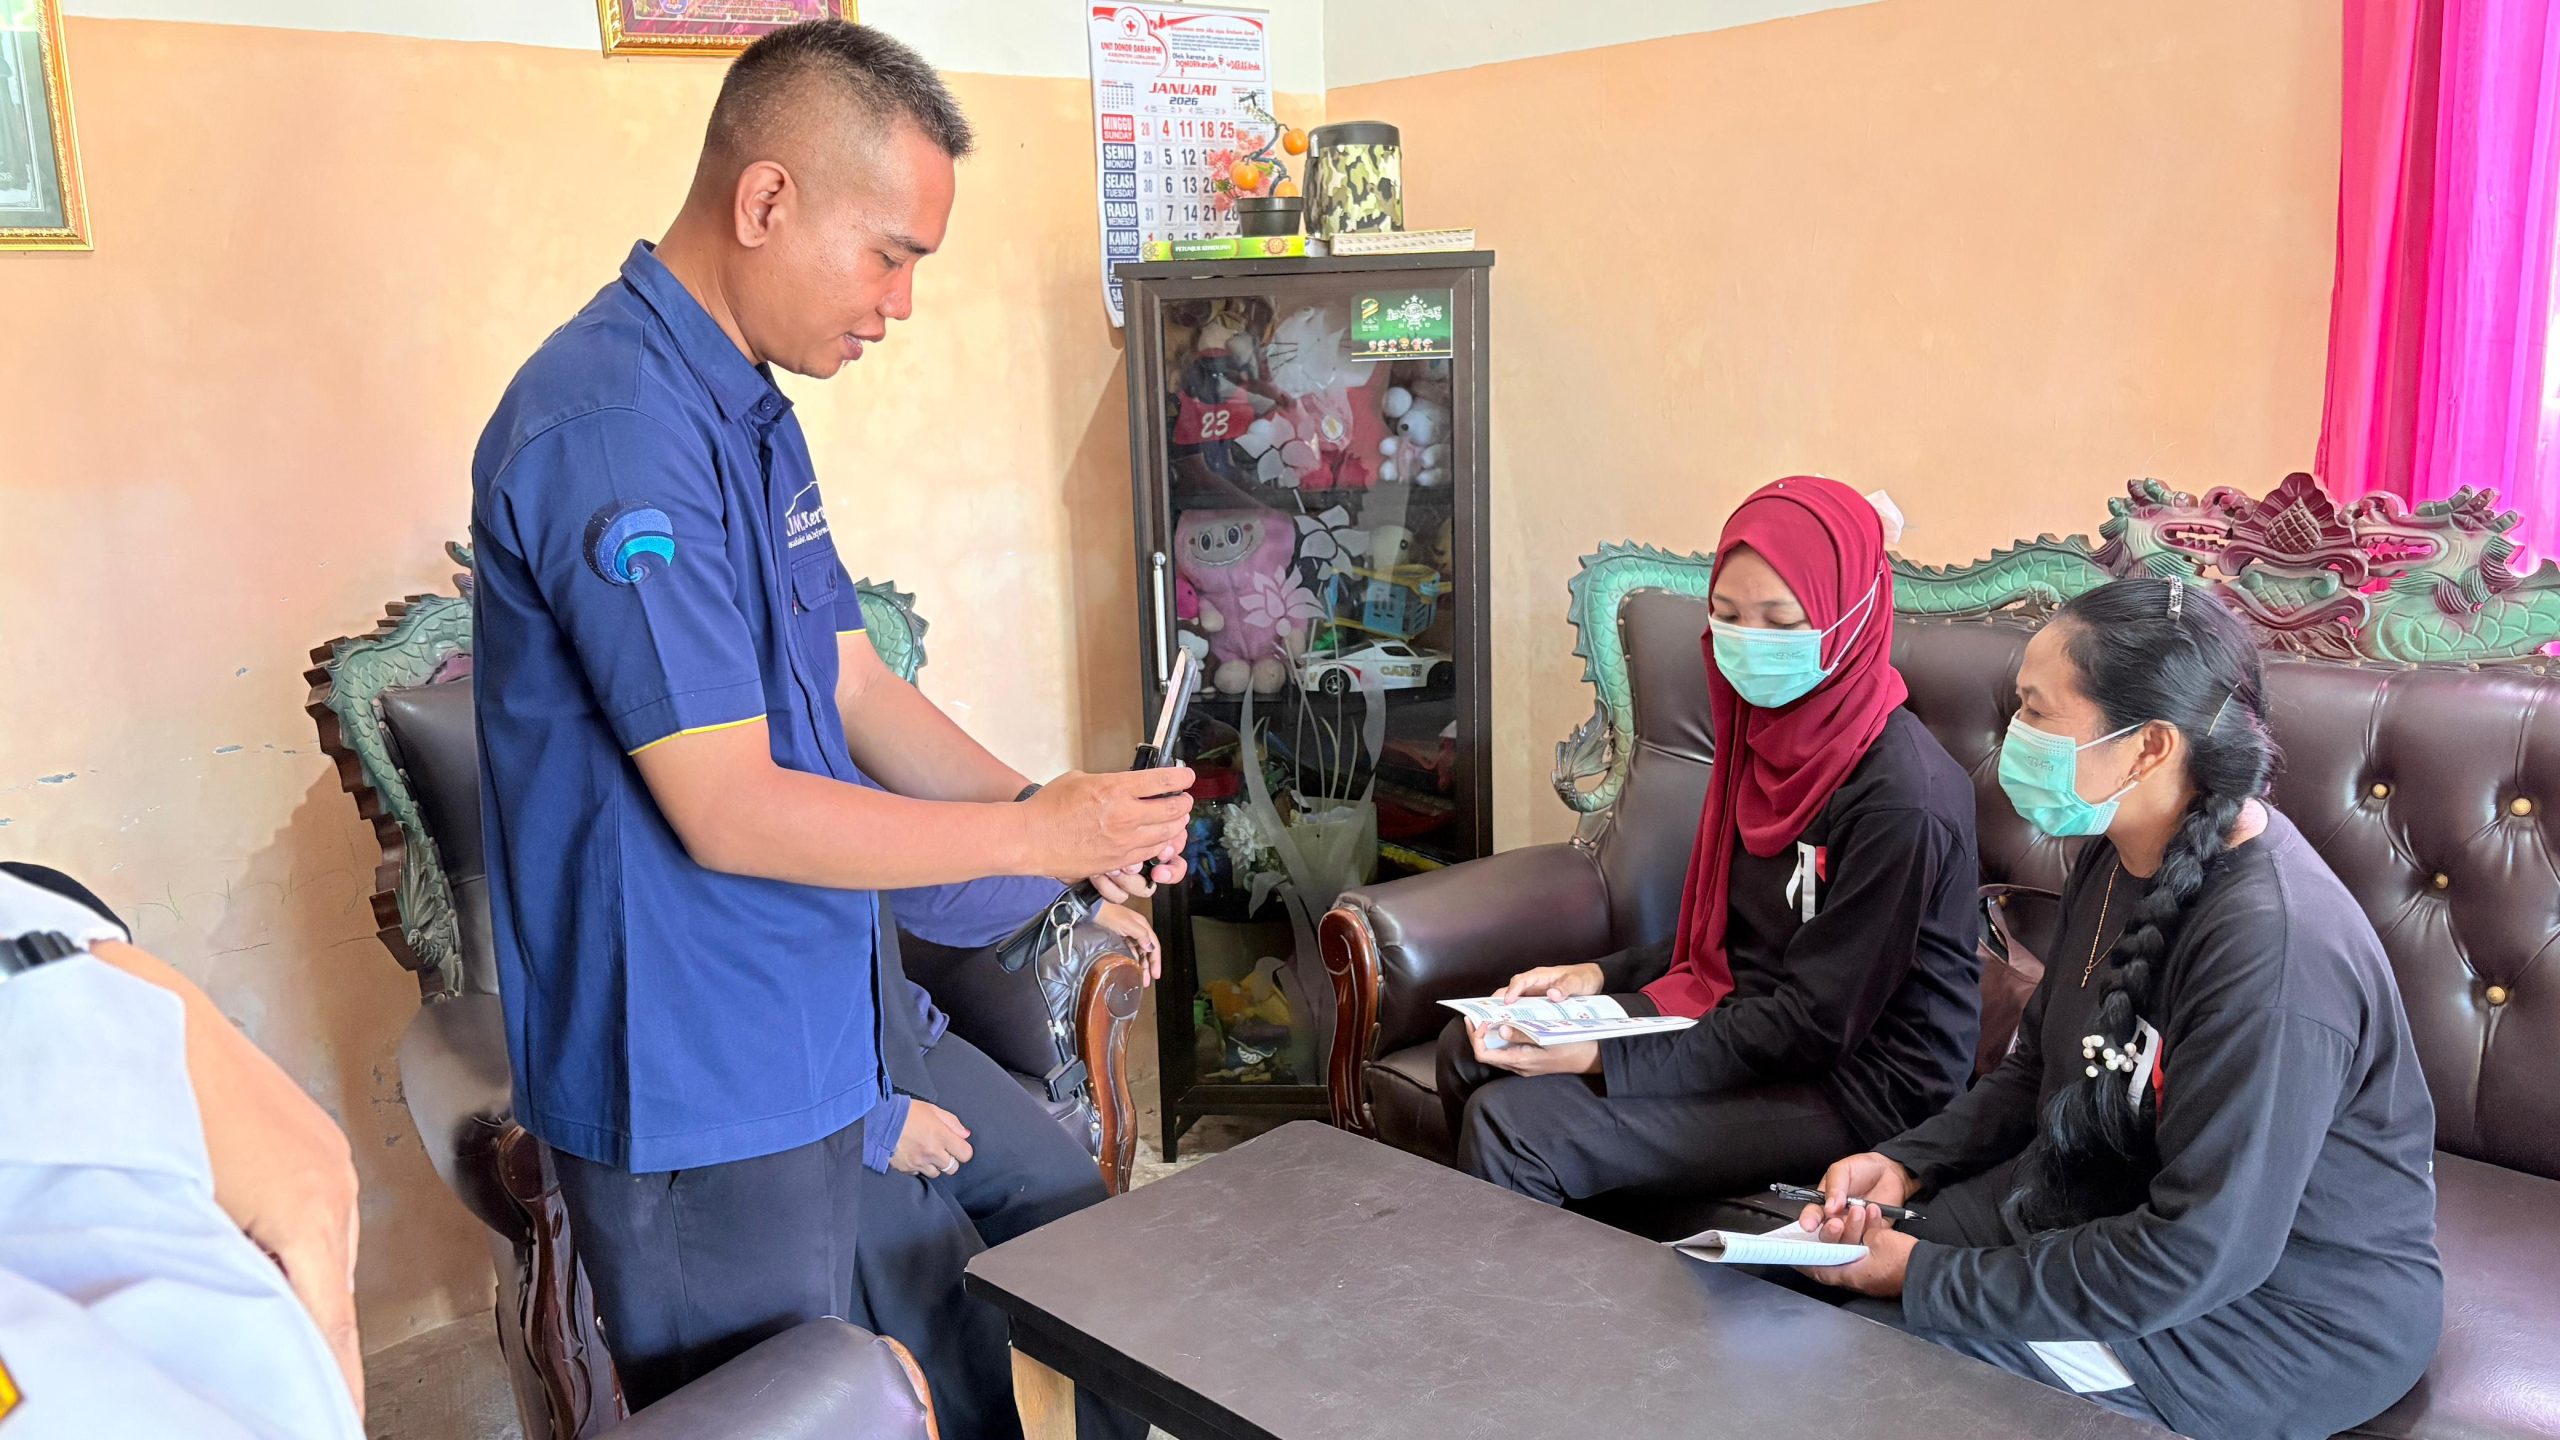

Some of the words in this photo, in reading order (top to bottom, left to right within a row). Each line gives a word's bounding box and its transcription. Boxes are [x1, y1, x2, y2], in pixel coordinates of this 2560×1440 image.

[1148, 82, 1217, 96] JANUARI
[1169, 97, 1199, 105] 2026
[1103, 116, 1132, 131] MINGGU
[1162, 119, 1170, 136] 4
[1179, 120, 1193, 138] 11
[1200, 120, 1214, 138] 18
[1219, 121, 1235, 139] 25
[1104, 131, 1133, 140] SUNDAY
[1105, 144, 1134, 160] SENIN
[1164, 148, 1173, 166] 5
[1181, 148, 1197, 166] 12
[1105, 160, 1134, 169] MONDAY
[1105, 173, 1135, 189] SELASA
[1165, 176, 1173, 194] 6
[1183, 176, 1197, 194] 13
[1105, 189, 1135, 197] TUESDAY
[1106, 202, 1136, 217] RABU
[1167, 204, 1173, 221] 7
[1184, 204, 1198, 221] 14
[1204, 204, 1217, 221] 21
[1109, 231, 1138, 246] KAMIS
[1201, 410, 1230, 439] 23
